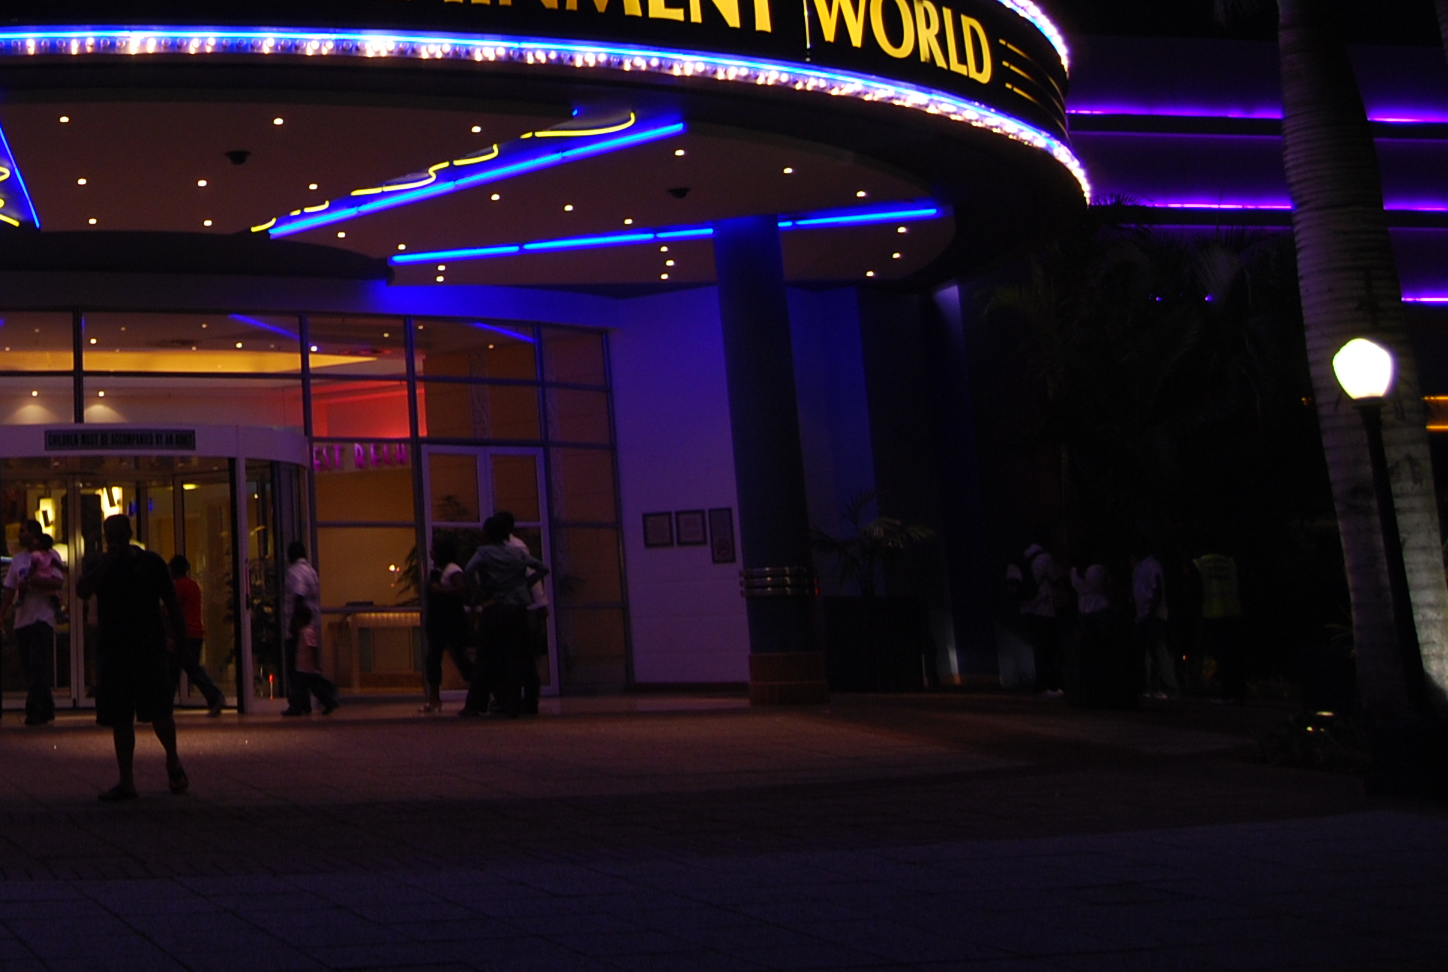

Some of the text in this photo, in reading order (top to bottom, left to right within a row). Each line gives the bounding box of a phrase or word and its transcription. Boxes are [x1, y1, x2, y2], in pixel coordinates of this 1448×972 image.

[48, 433, 193, 447] CHILDREN MUST BE ACCOMPANIED BY AN ADULT
